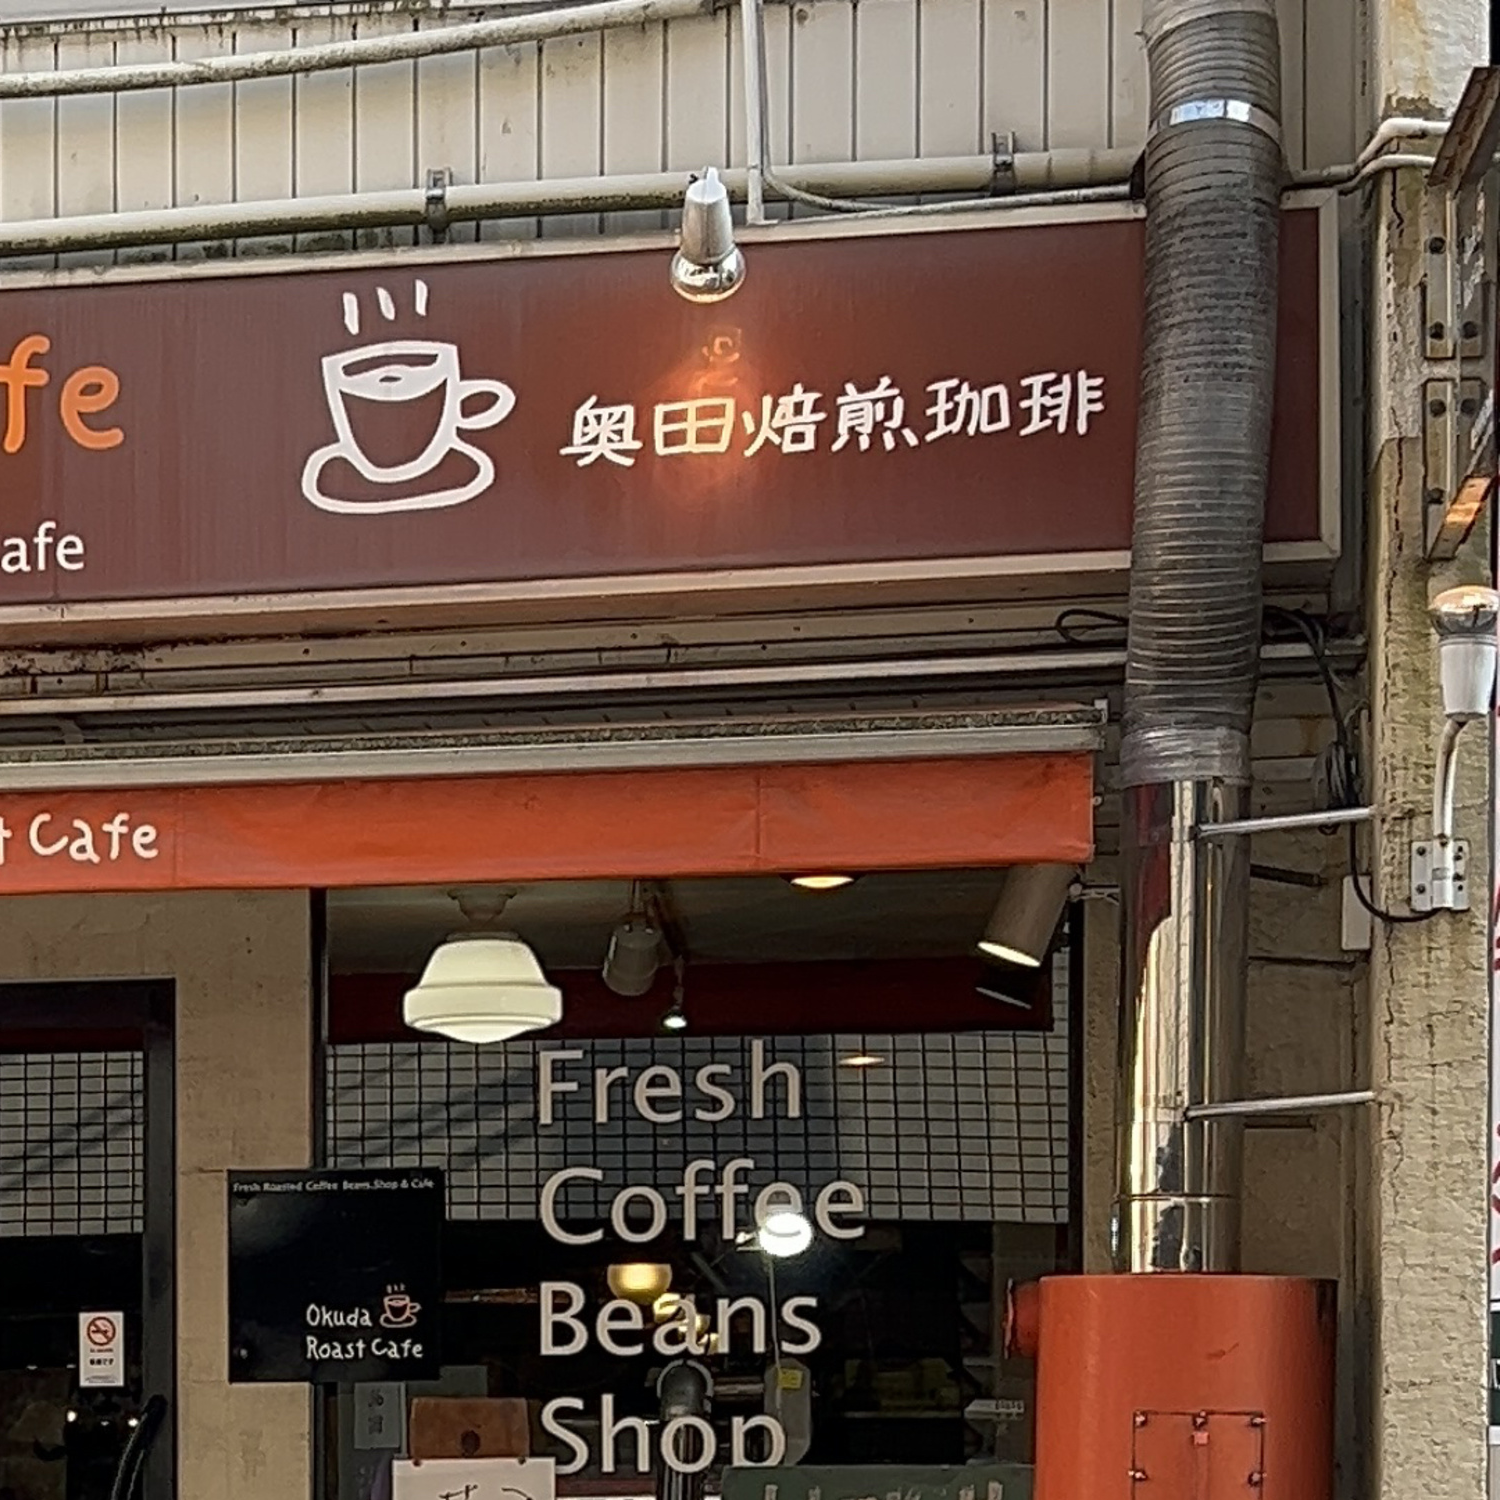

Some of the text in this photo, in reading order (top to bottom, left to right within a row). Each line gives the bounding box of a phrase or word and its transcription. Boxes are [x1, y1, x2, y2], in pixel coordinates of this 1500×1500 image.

[560, 369, 1106, 468] 奥田焙煎珈琲
[28, 811, 160, 864] Cafe
[538, 1038, 802, 1126] Fresh
[539, 1158, 867, 1245] Coffee
[306, 1303, 373, 1328] Okuda
[306, 1336, 424, 1360] Roast Cafe
[539, 1281, 824, 1356] Beans
[541, 1394, 787, 1476] Shop
